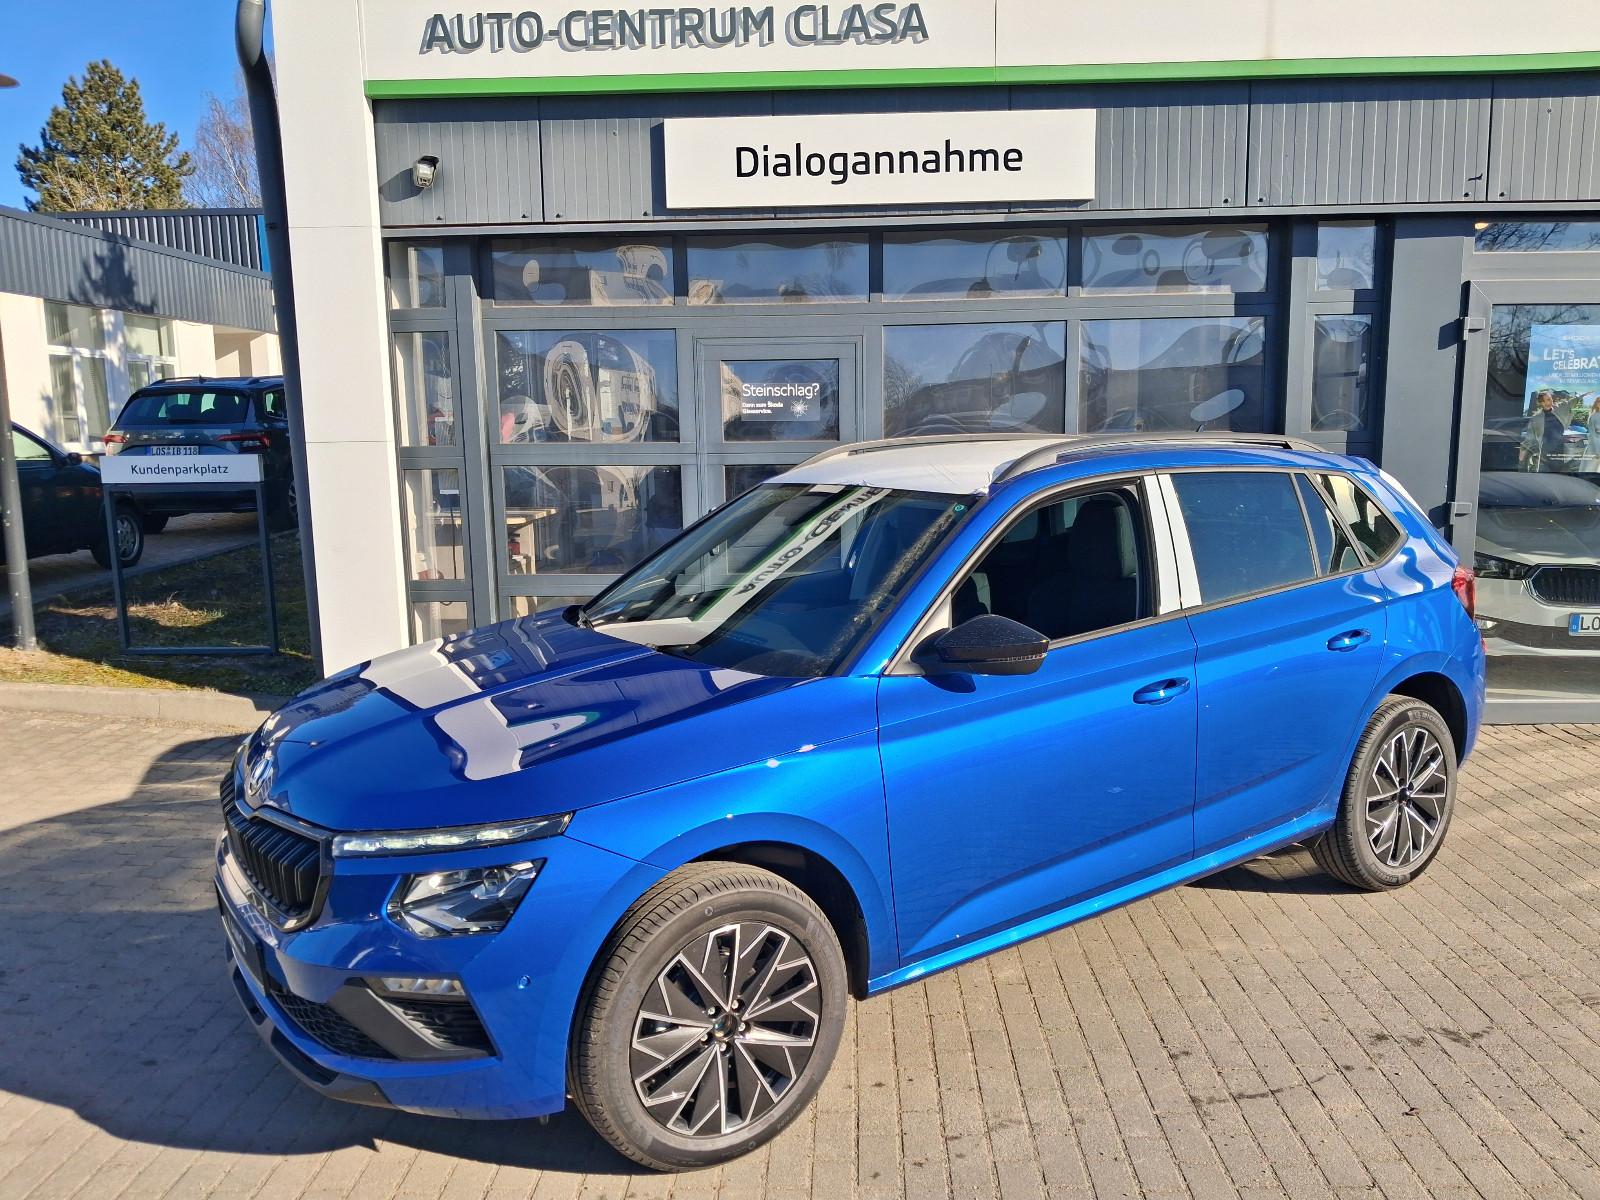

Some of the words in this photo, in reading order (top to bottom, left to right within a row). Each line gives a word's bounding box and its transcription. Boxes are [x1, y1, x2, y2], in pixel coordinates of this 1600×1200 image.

[421, 8, 774, 53] AUTO-CENTRUM
[788, 3, 929, 46] CLASA
[735, 140, 1023, 185] Dialogannahme
[1543, 348, 1575, 361] LET'S
[742, 383, 820, 399] Steinschlag?
[151, 447, 166, 456] LOS
[183, 447, 198, 456] 118
[130, 464, 229, 477] Kundenparkplatz
